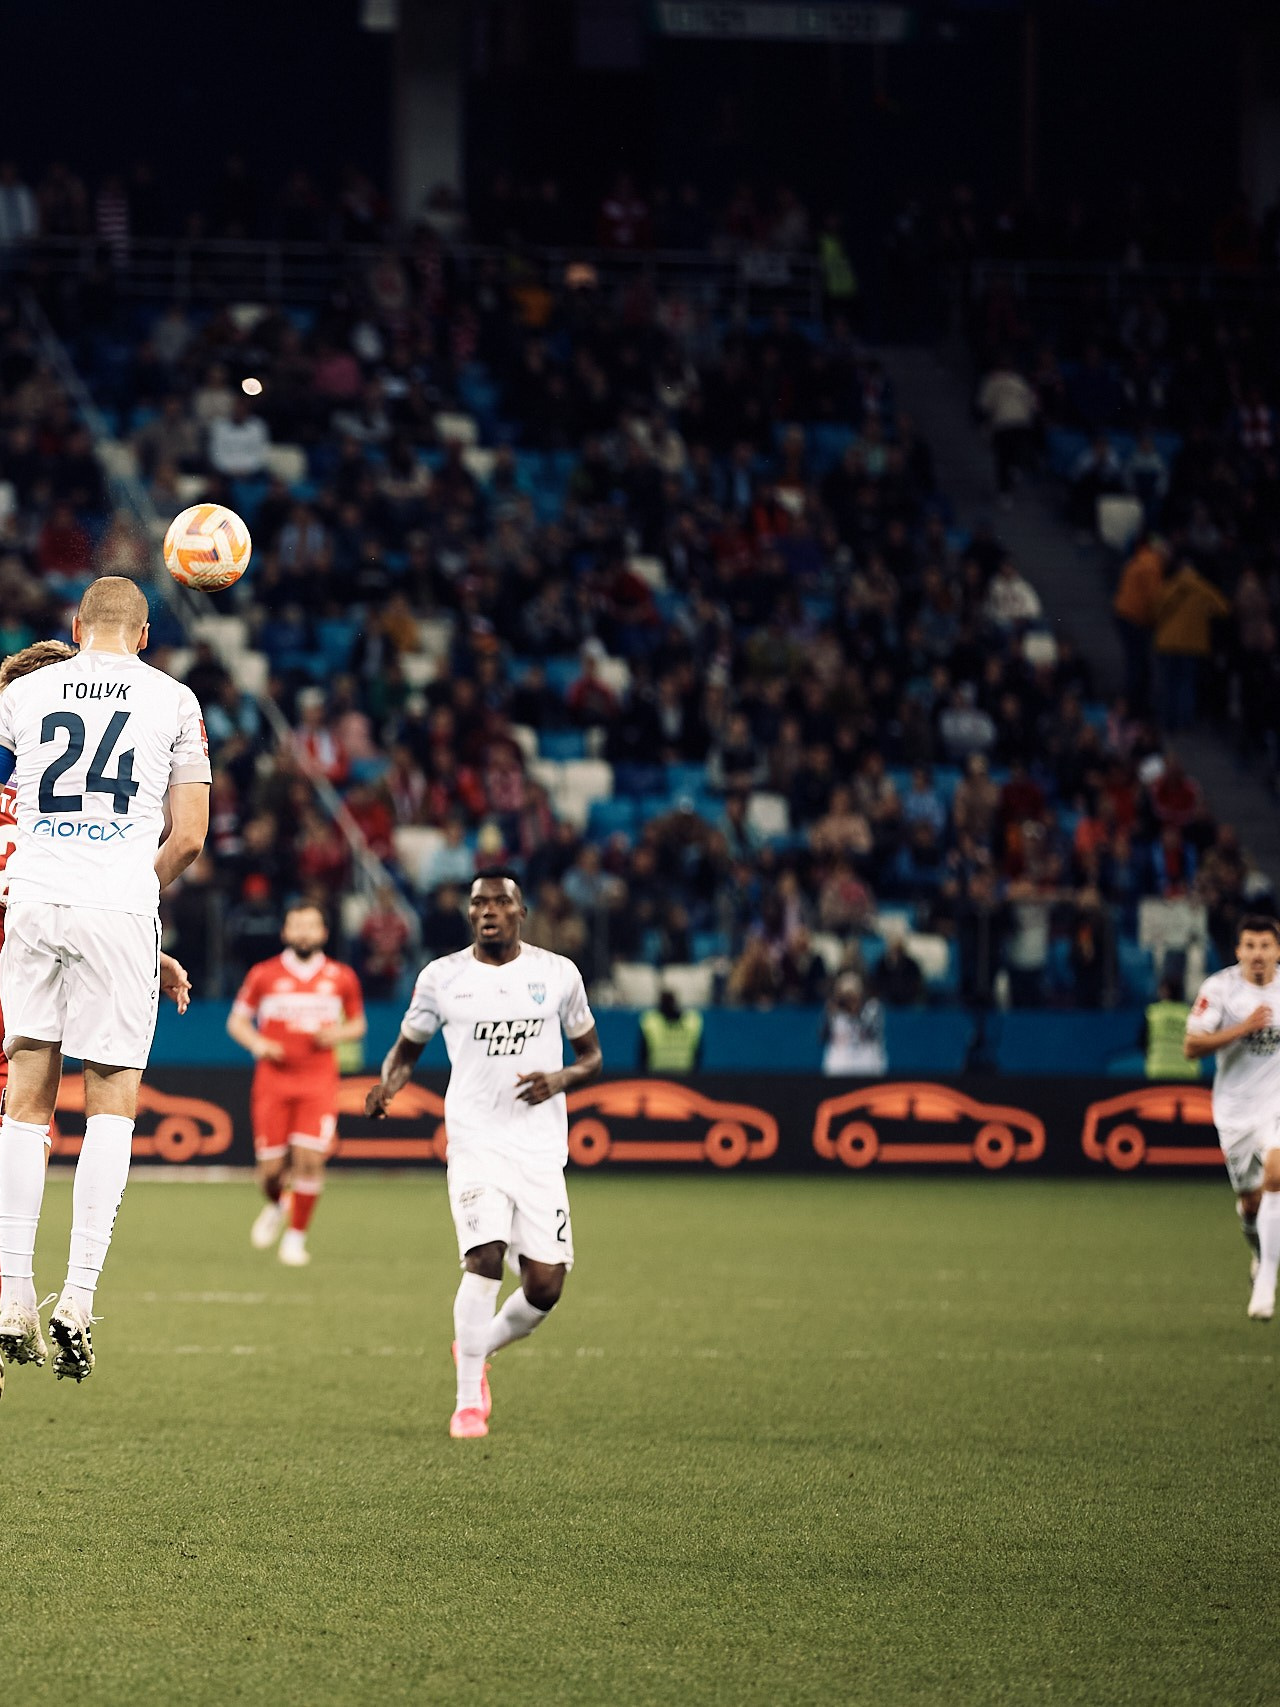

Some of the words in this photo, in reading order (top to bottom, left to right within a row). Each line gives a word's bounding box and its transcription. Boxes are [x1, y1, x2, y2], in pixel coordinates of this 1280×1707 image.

[63, 682, 131, 700] ГОЦУК
[38, 711, 139, 814] 24
[474, 1018, 544, 1040] ПАРИ
[487, 1037, 526, 1056] НН
[556, 1208, 567, 1243] 2
